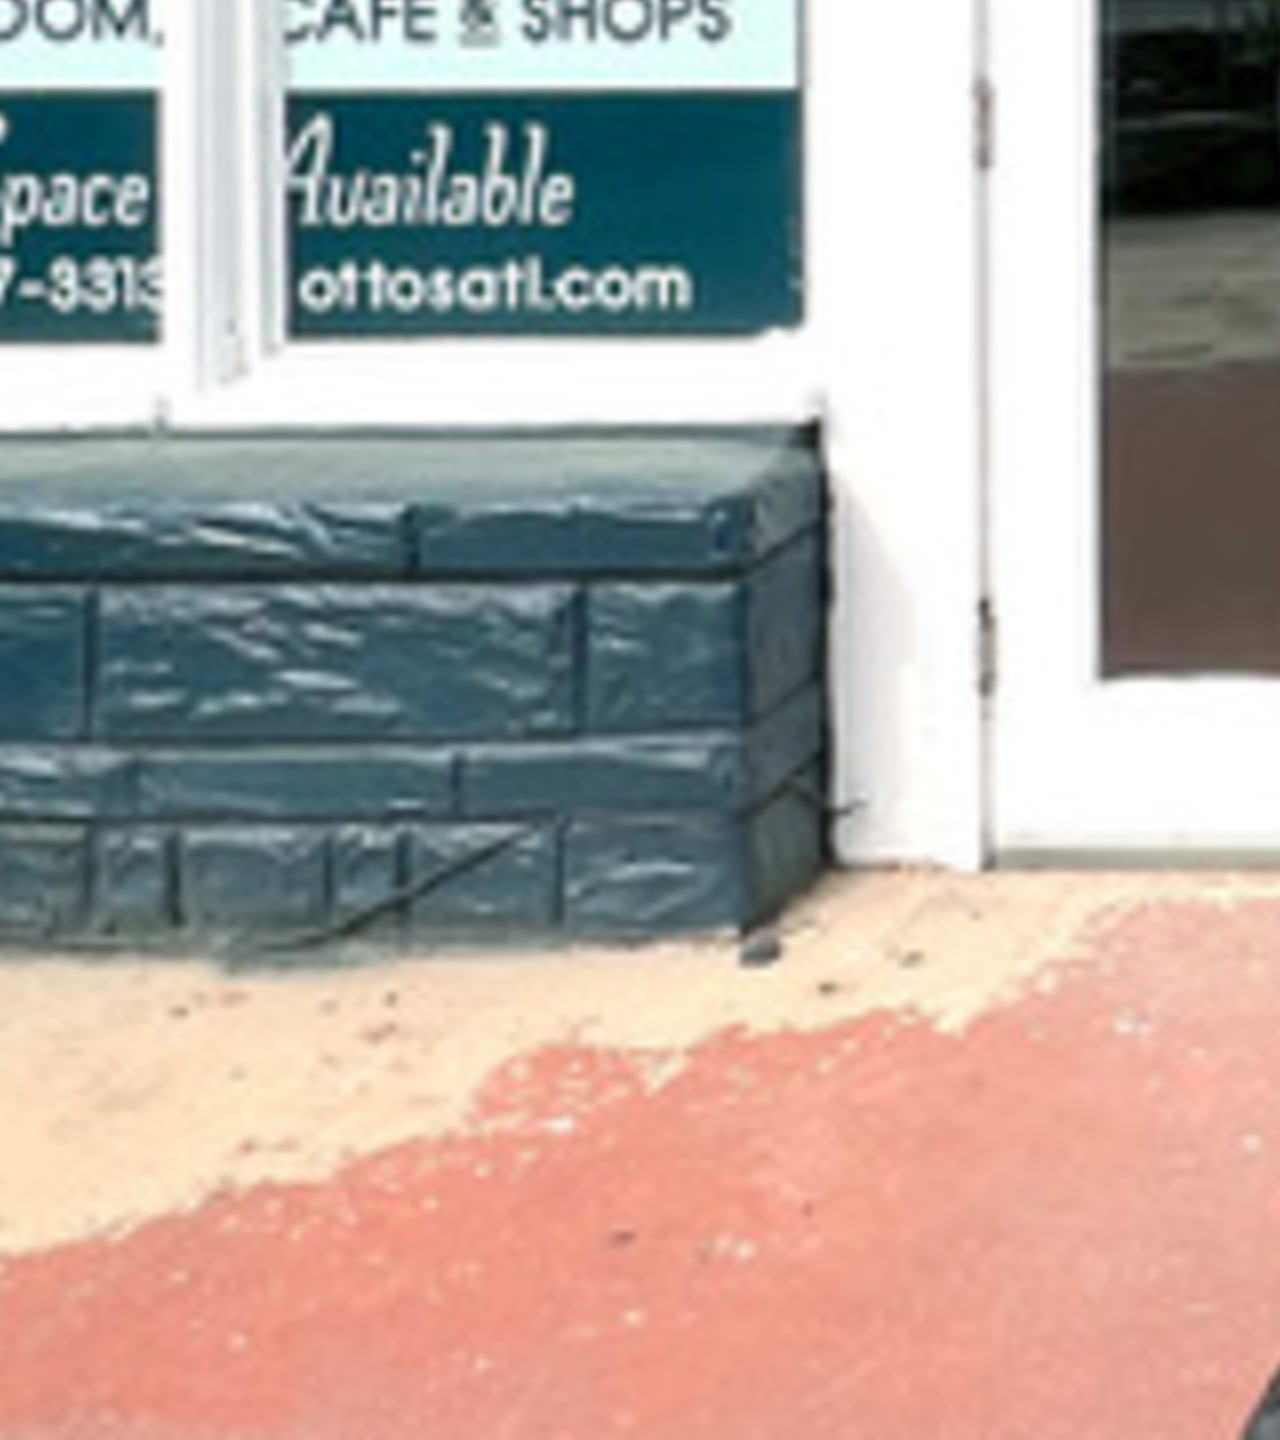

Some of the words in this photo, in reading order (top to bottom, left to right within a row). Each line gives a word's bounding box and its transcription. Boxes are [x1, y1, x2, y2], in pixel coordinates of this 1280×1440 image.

[0, 114, 149, 248] pace
[286, 112, 574, 227] Available
[299, 256, 692, 311] ottosatl.com
